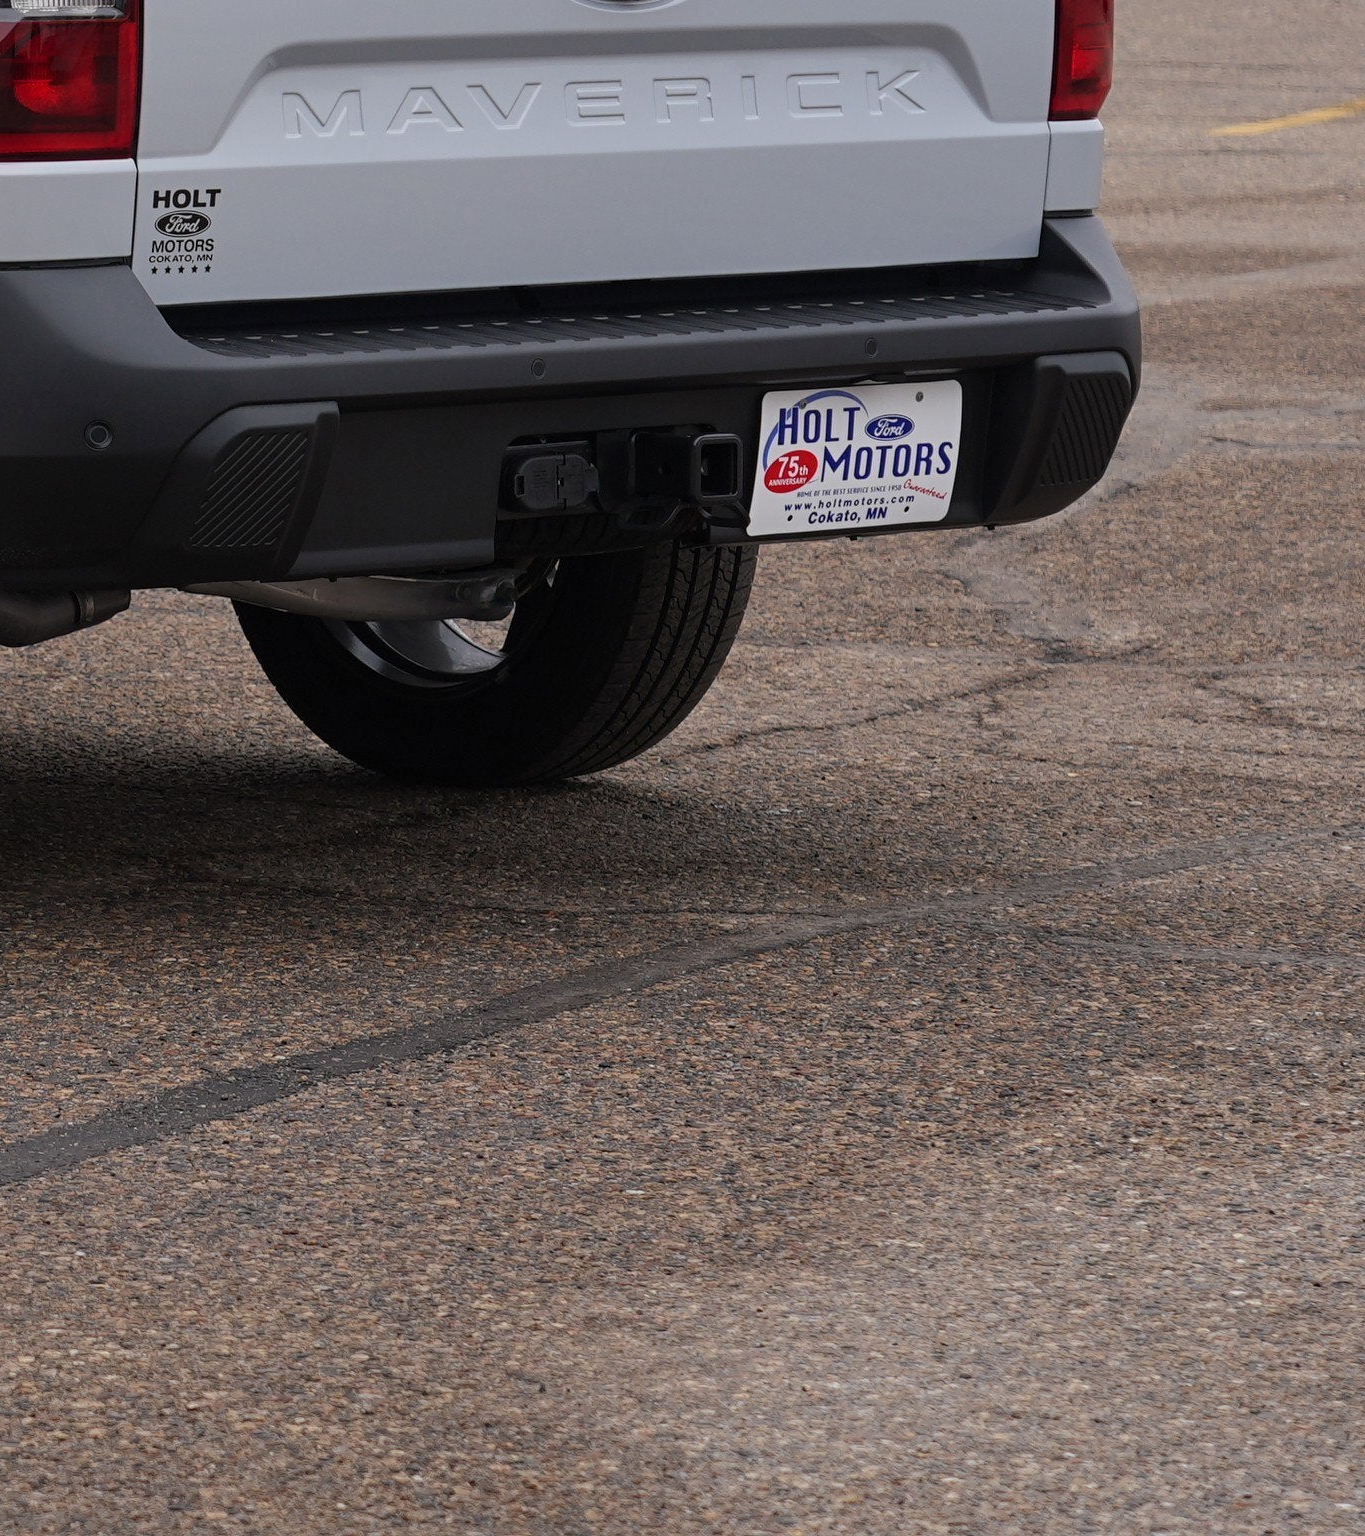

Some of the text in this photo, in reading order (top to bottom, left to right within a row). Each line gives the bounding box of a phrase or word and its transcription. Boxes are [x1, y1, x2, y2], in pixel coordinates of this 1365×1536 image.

[282, 69, 927, 139] MAVERICK
[152, 188, 222, 209] HOLT
[165, 214, 201, 233] Ford
[151, 238, 215, 253] MOTORS
[149, 254, 213, 264] COKATO, MN
[777, 406, 861, 446] HOLT
[873, 419, 905, 437] Ford
[778, 455, 809, 478] 75th
[821, 441, 953, 482] MOTORS
[768, 477, 807, 487] ANNIVERSARY
[832, 488, 846, 496] BEST
[847, 486, 868, 495] SERVICE
[870, 485, 886, 493] SINCE
[903, 478, 948, 500] Guaranteed
[784, 495, 915, 511] www.holtmotors.com
[808, 506, 888, 524] Cokato, MN
